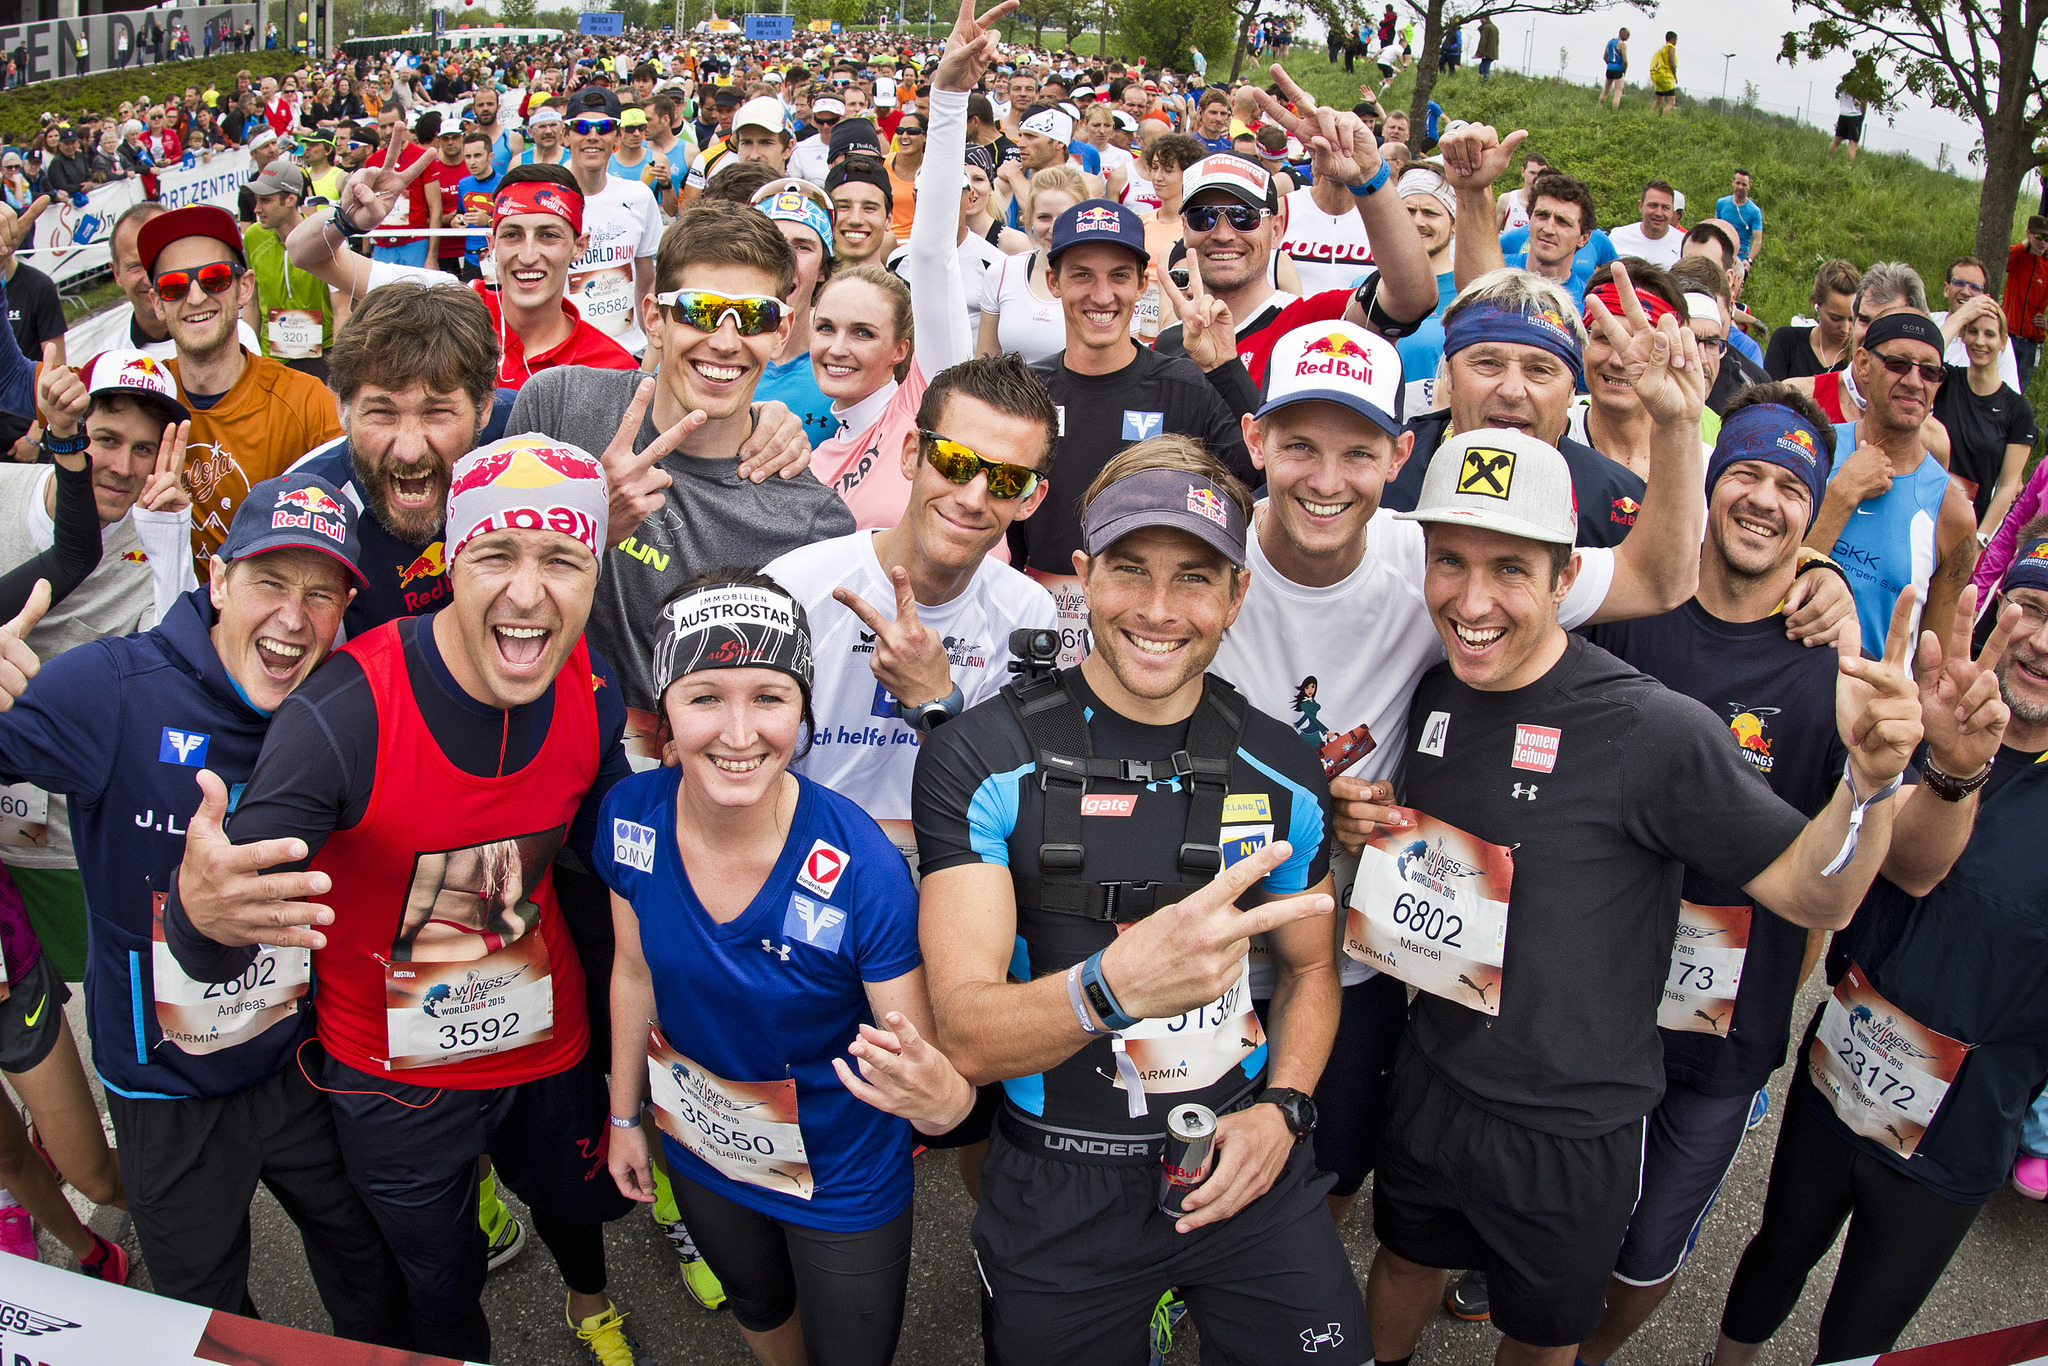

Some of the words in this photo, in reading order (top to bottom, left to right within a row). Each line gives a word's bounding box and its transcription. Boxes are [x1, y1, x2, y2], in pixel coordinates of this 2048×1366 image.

[591, 16, 608, 24] BLOCK
[756, 20, 777, 28] BLOCK
[540, 198, 564, 216] WORLD
[1077, 221, 1097, 233] Red
[1099, 221, 1120, 233] Bull
[1280, 240, 1376, 262] COCOO
[588, 296, 628, 317] 56582
[283, 332, 309, 343] 3201
[1902, 323, 1925, 334] GORE
[1296, 360, 1334, 377] Red
[1336, 358, 1373, 386] Bull
[119, 373, 145, 388] Red
[147, 377, 167, 395] Bull
[182, 452, 235, 504] aloja
[1188, 500, 1209, 517] Red
[1210, 508, 1227, 528] Bull
[1611, 511, 1628, 525] Red
[272, 511, 308, 529] Red
[312, 516, 346, 545] Bull
[1833, 539, 1881, 571] GKK
[404, 585, 443, 613] Red
[700, 593, 768, 606] IMMOBILIEN
[679, 603, 791, 632] AUSTROSTAR
[852, 644, 875, 654] erim
[813, 727, 832, 746] ch
[837, 726, 887, 747] helfe
[891, 728, 920, 747] lau
[1517, 728, 1558, 751] Kronen
[1051, 757, 1073, 766] GARMIN
[1514, 745, 1555, 769] Zeitung
[1081, 796, 1131, 817] lgate
[616, 844, 653, 869] OMV
[1427, 849, 1462, 874] WINGS
[1427, 863, 1448, 882] LIFE
[798, 874, 831, 897] bundesheer
[1443, 885, 1457, 901] 2015
[1392, 891, 1464, 949] 6802
[1349, 938, 1398, 968] GARMIN
[1399, 936, 1442, 962] Marcel
[1678, 944, 1695, 956] 2015
[393, 971, 416, 979] AUSTRIA
[454, 976, 504, 997] WINGS
[461, 989, 490, 1005] LIFE
[216, 997, 267, 1017] Andreas
[487, 996, 506, 1008] 2015
[164, 1028, 220, 1043] GARMIN
[438, 1012, 520, 1050] 3592
[1872, 1019, 1912, 1052] WINGS
[1871, 1032, 1897, 1052] LIFE
[1887, 1055, 1904, 1071] 2015
[1138, 1066, 1190, 1082] ARMIN
[1809, 1060, 1840, 1100] GARMIN
[1837, 1037, 1916, 1111] 23172
[692, 1075, 733, 1109] WINGS
[698, 1088, 720, 1110] LIFE
[1851, 1083, 1876, 1110] Peter
[680, 1098, 775, 1156] 35550
[720, 1112, 740, 1125] 2015
[700, 1136, 757, 1165] Jaqueline
[1044, 1133, 1149, 1157] UNDER
[1176, 1166, 1203, 1179] Bull
